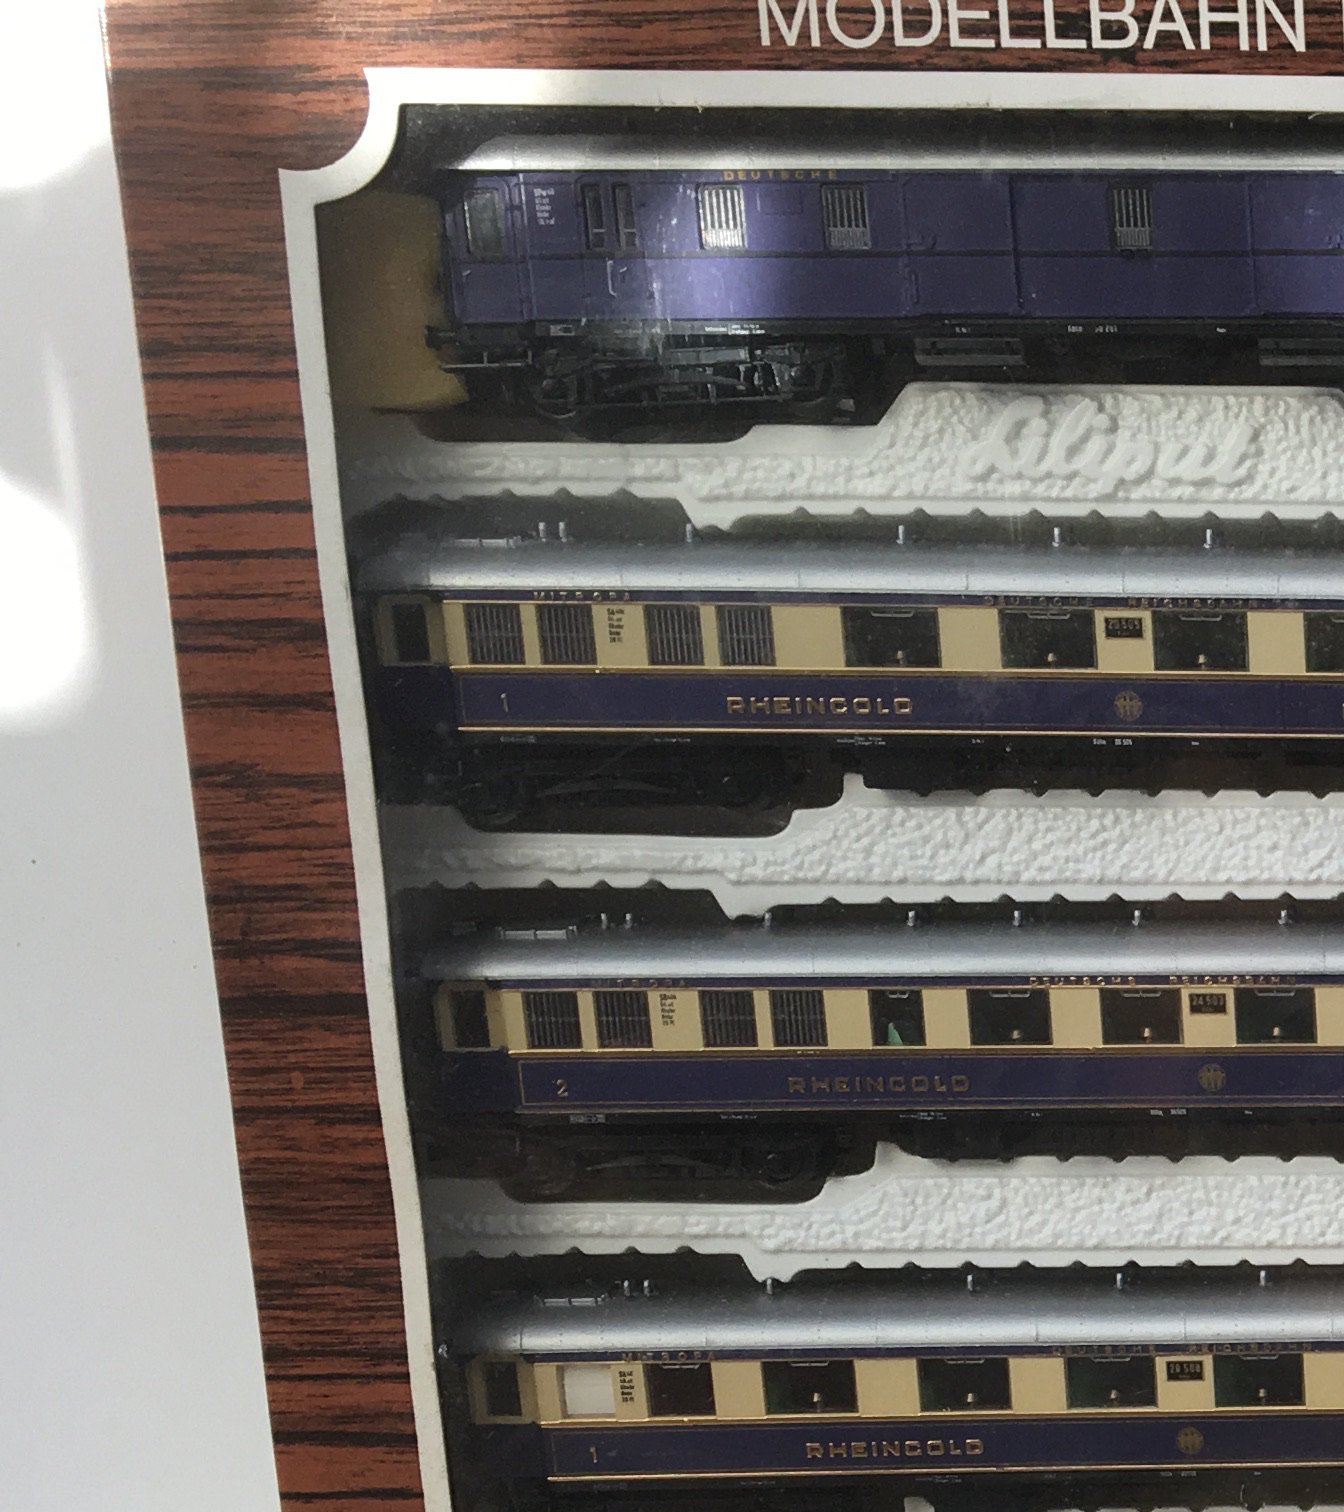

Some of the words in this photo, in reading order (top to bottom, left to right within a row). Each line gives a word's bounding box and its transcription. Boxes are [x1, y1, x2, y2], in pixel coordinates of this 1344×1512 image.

[758, 0, 1307, 53] MODELLBAHN
[726, 696, 913, 715] RHEINGOLD
[555, 1079, 570, 1097] 2
[788, 1074, 972, 1094] RHEINGOLD
[805, 1439, 985, 1459] RHEINGOLD
